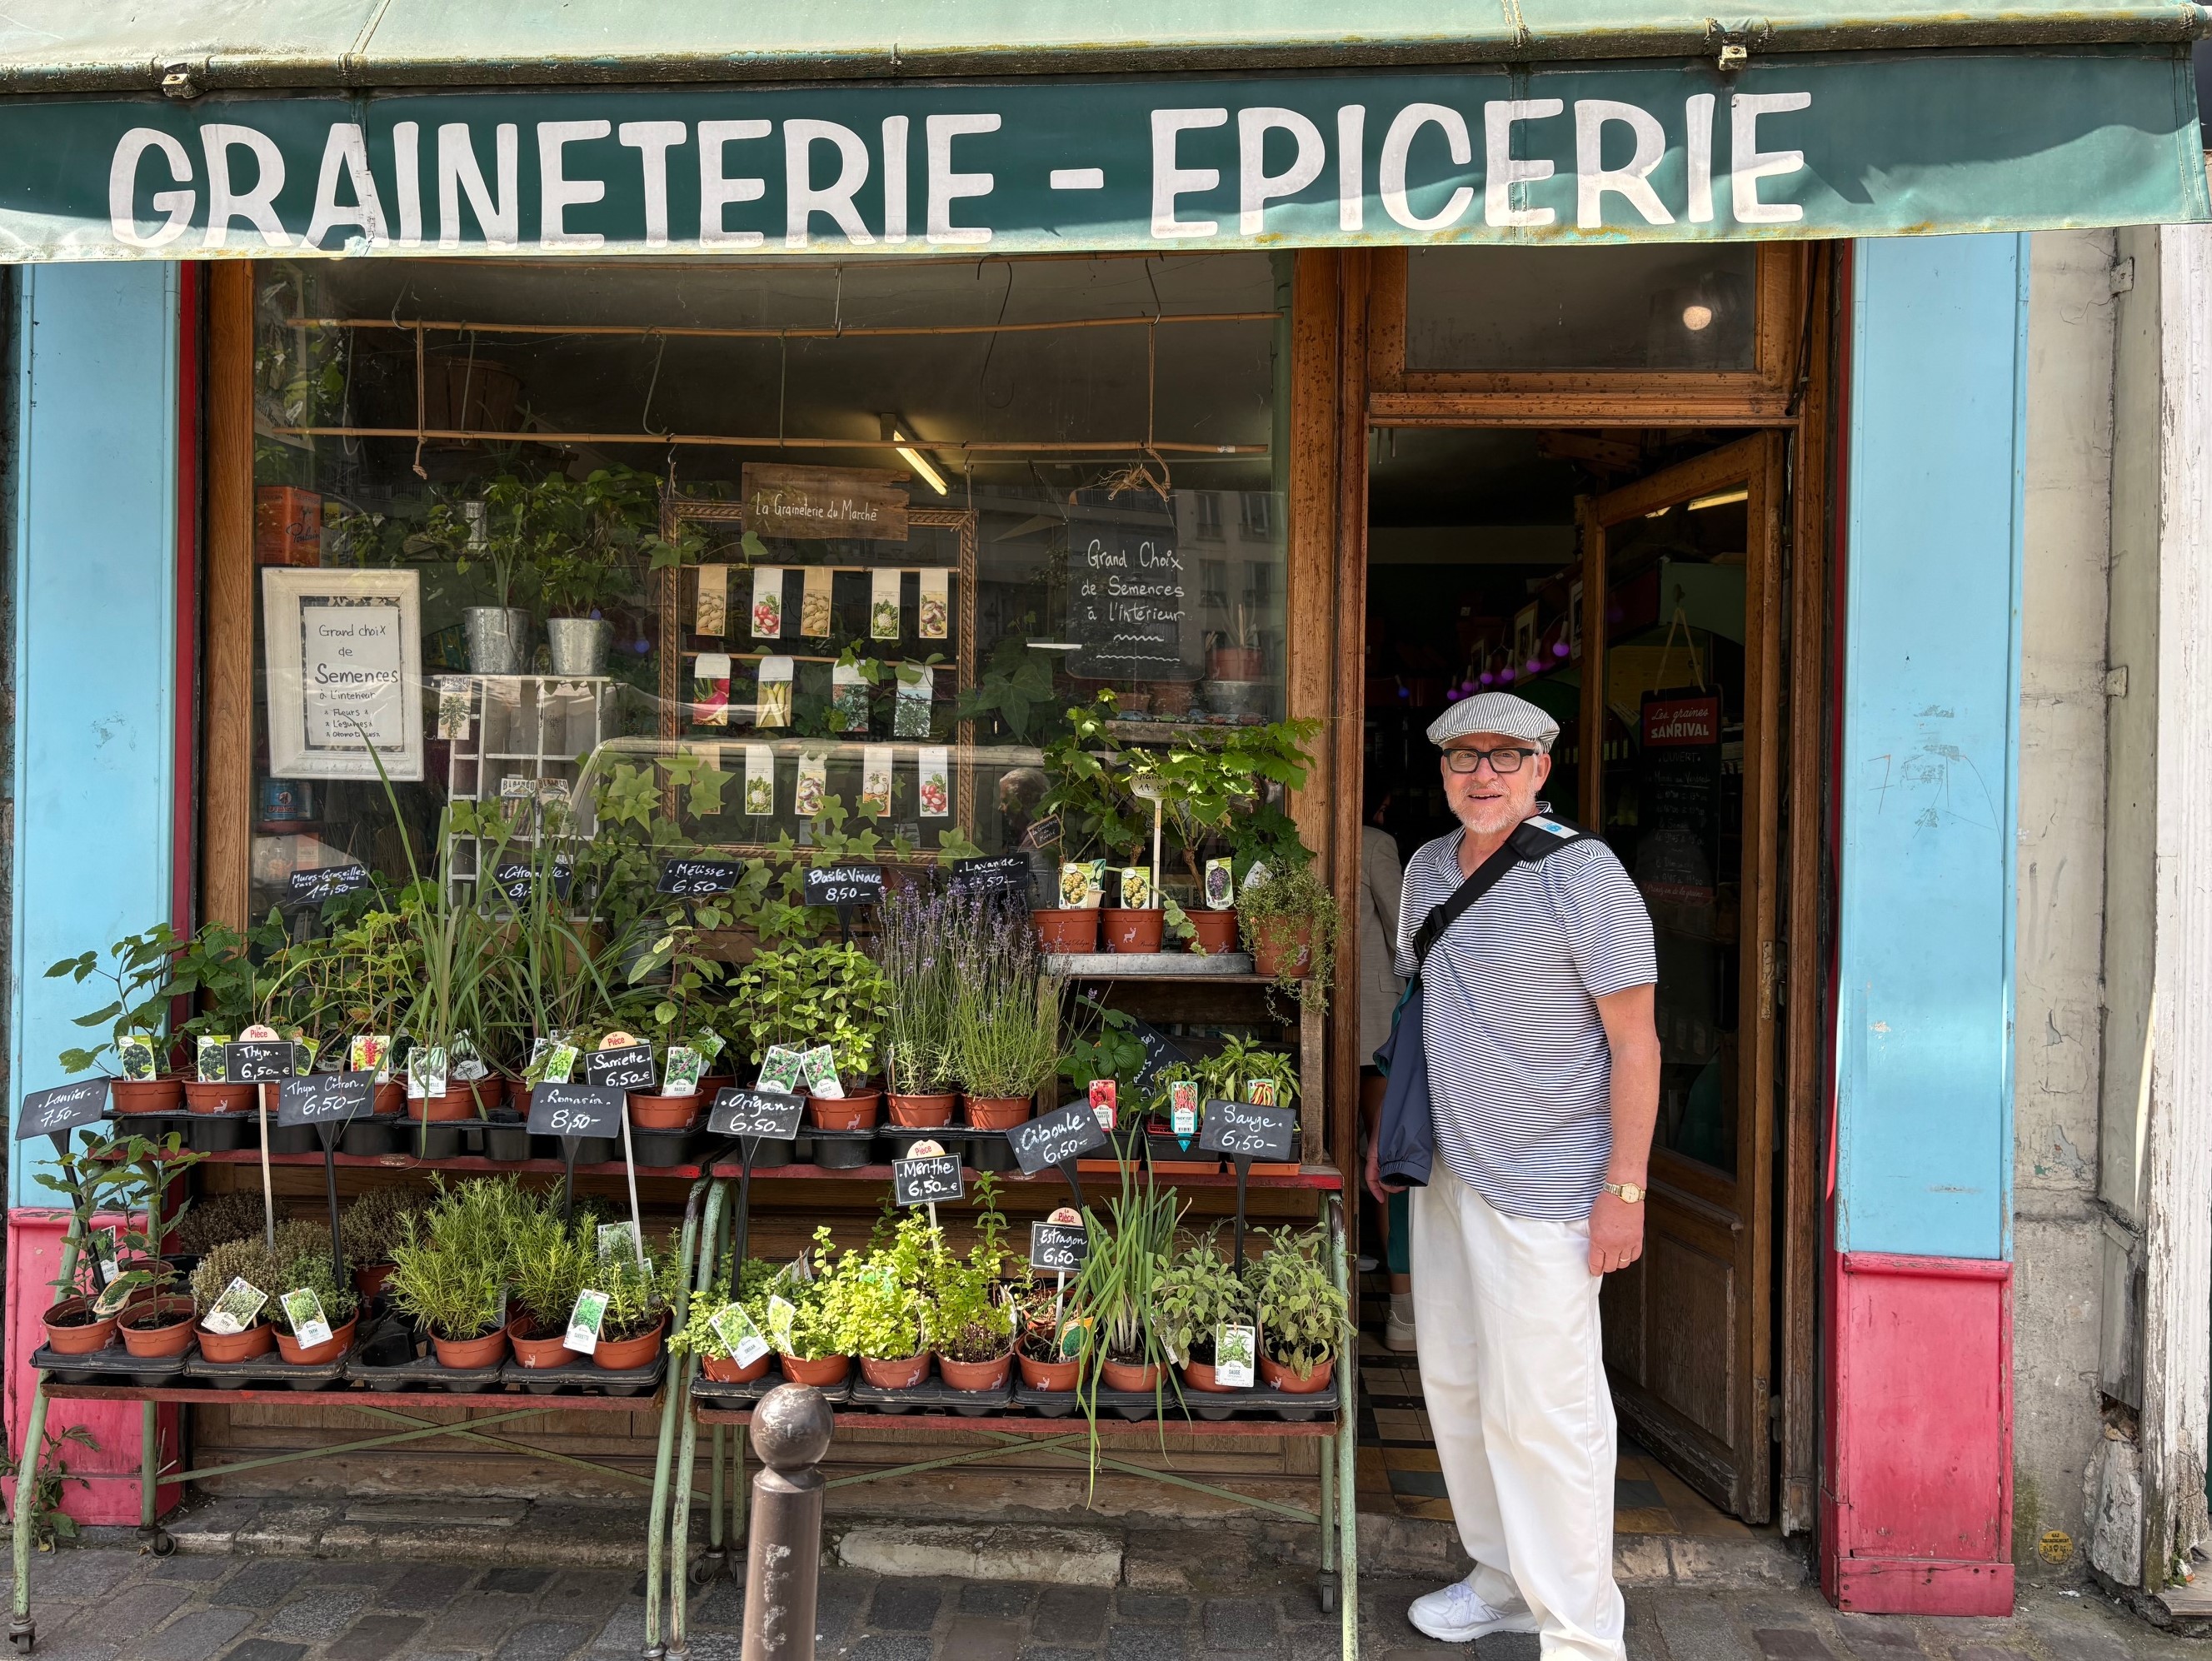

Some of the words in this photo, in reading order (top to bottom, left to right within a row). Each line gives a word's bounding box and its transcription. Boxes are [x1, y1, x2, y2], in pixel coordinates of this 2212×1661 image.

[108, 113, 1001, 257] GRAINETERIE
[1150, 92, 1811, 240] EPICERIE
[756, 491, 769, 516] La
[774, 494, 824, 518] Graineterie
[827, 501, 838, 518] du
[1087, 540, 1127, 569] Grand
[1140, 541, 1184, 571] Choix
[1081, 580, 1097, 596] de
[1108, 576, 1185, 597] Semences
[318, 625, 354, 637] Grand
[338, 647, 352, 657] de
[315, 663, 399, 684] Semences
[1651, 708, 1670, 721] Les
[1672, 706, 1710, 723] graines
[1651, 722, 1710, 739] SANRIVAL
[677, 863, 725, 875] Mélisse
[966, 858, 1020, 871] Lavande
[811, 868, 848, 885] Basilic
[250, 1030, 268, 1039] Pièce
[607, 1037, 625, 1047] Pièce
[239, 1045, 272, 1061] Thym
[593, 1052, 647, 1070] Sarriette
[287, 1080, 316, 1097] Thym
[325, 1075, 359, 1092] Citron
[44, 1087, 92, 1108] Laurier
[729, 1094, 788, 1117] Origan
[1225, 1105, 1276, 1132] Sauge
[1021, 1113, 1085, 1150] Ciboule
[915, 1146, 932, 1156] Pièce
[904, 1158, 954, 1178] Menthe
[1059, 1213, 1074, 1222] Pièce
[1041, 1228, 1087, 1248] Estragon
